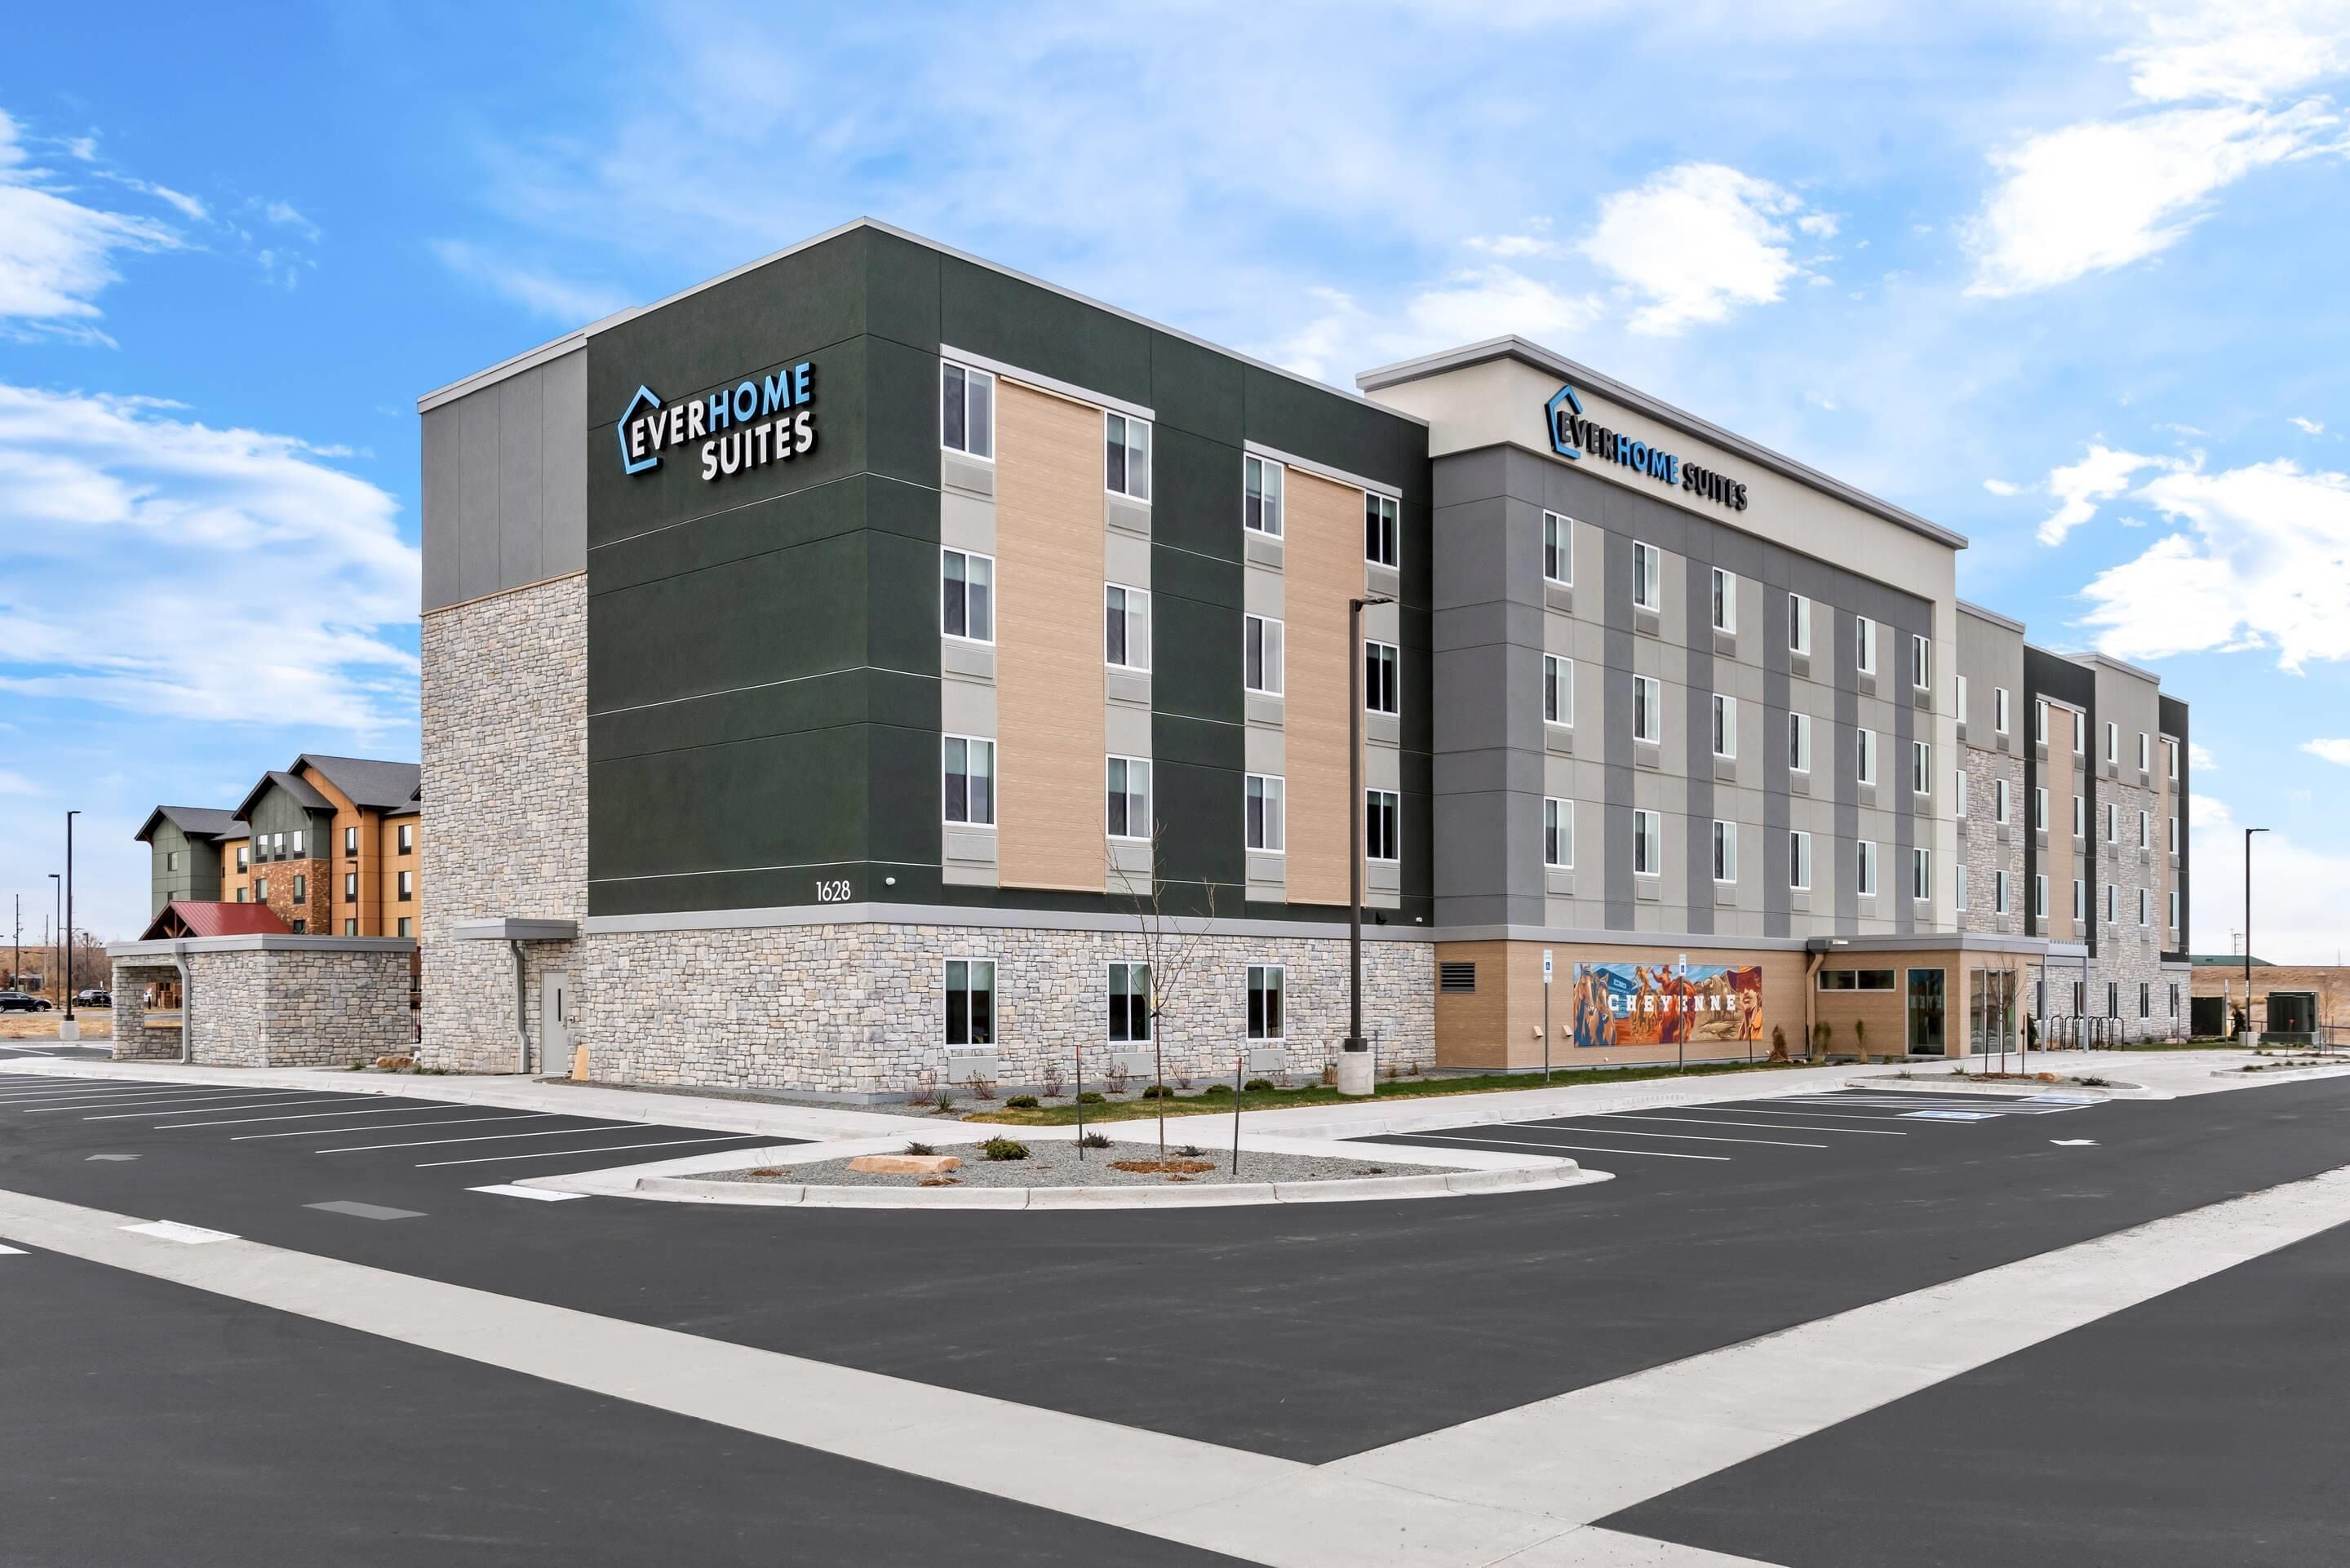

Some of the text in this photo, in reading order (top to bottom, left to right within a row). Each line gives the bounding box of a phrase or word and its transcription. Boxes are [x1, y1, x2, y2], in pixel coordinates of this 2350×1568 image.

[632, 361, 812, 458] EVERHOME
[702, 411, 814, 481] SUITES
[1556, 410, 1748, 511] EVERHOME SUITES
[816, 880, 851, 901] 1628
[1607, 994, 1736, 1012] CHEYENNE
